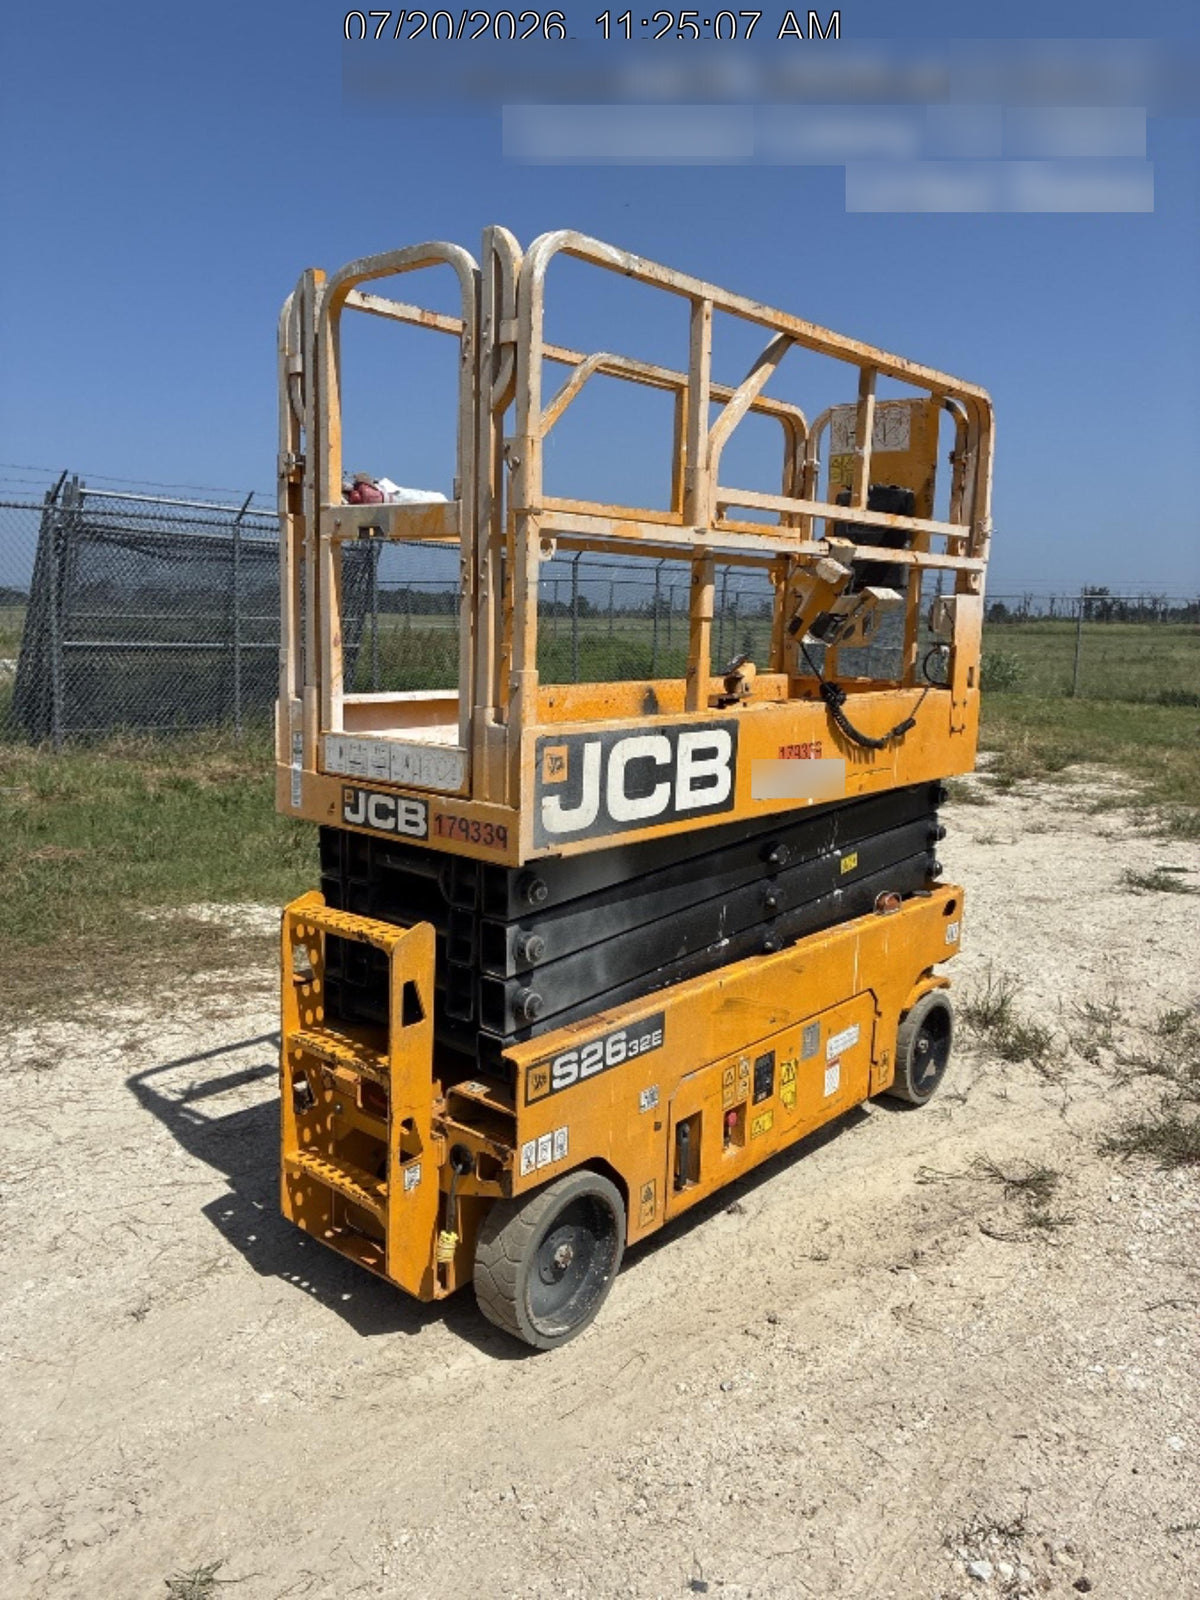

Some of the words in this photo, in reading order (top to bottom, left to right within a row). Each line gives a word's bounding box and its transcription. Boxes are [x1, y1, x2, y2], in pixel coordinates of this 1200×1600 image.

[542, 729, 732, 833] JCB
[344, 790, 429, 837] JCB
[433, 813, 508, 849] 179339
[551, 1030, 628, 1090] S26
